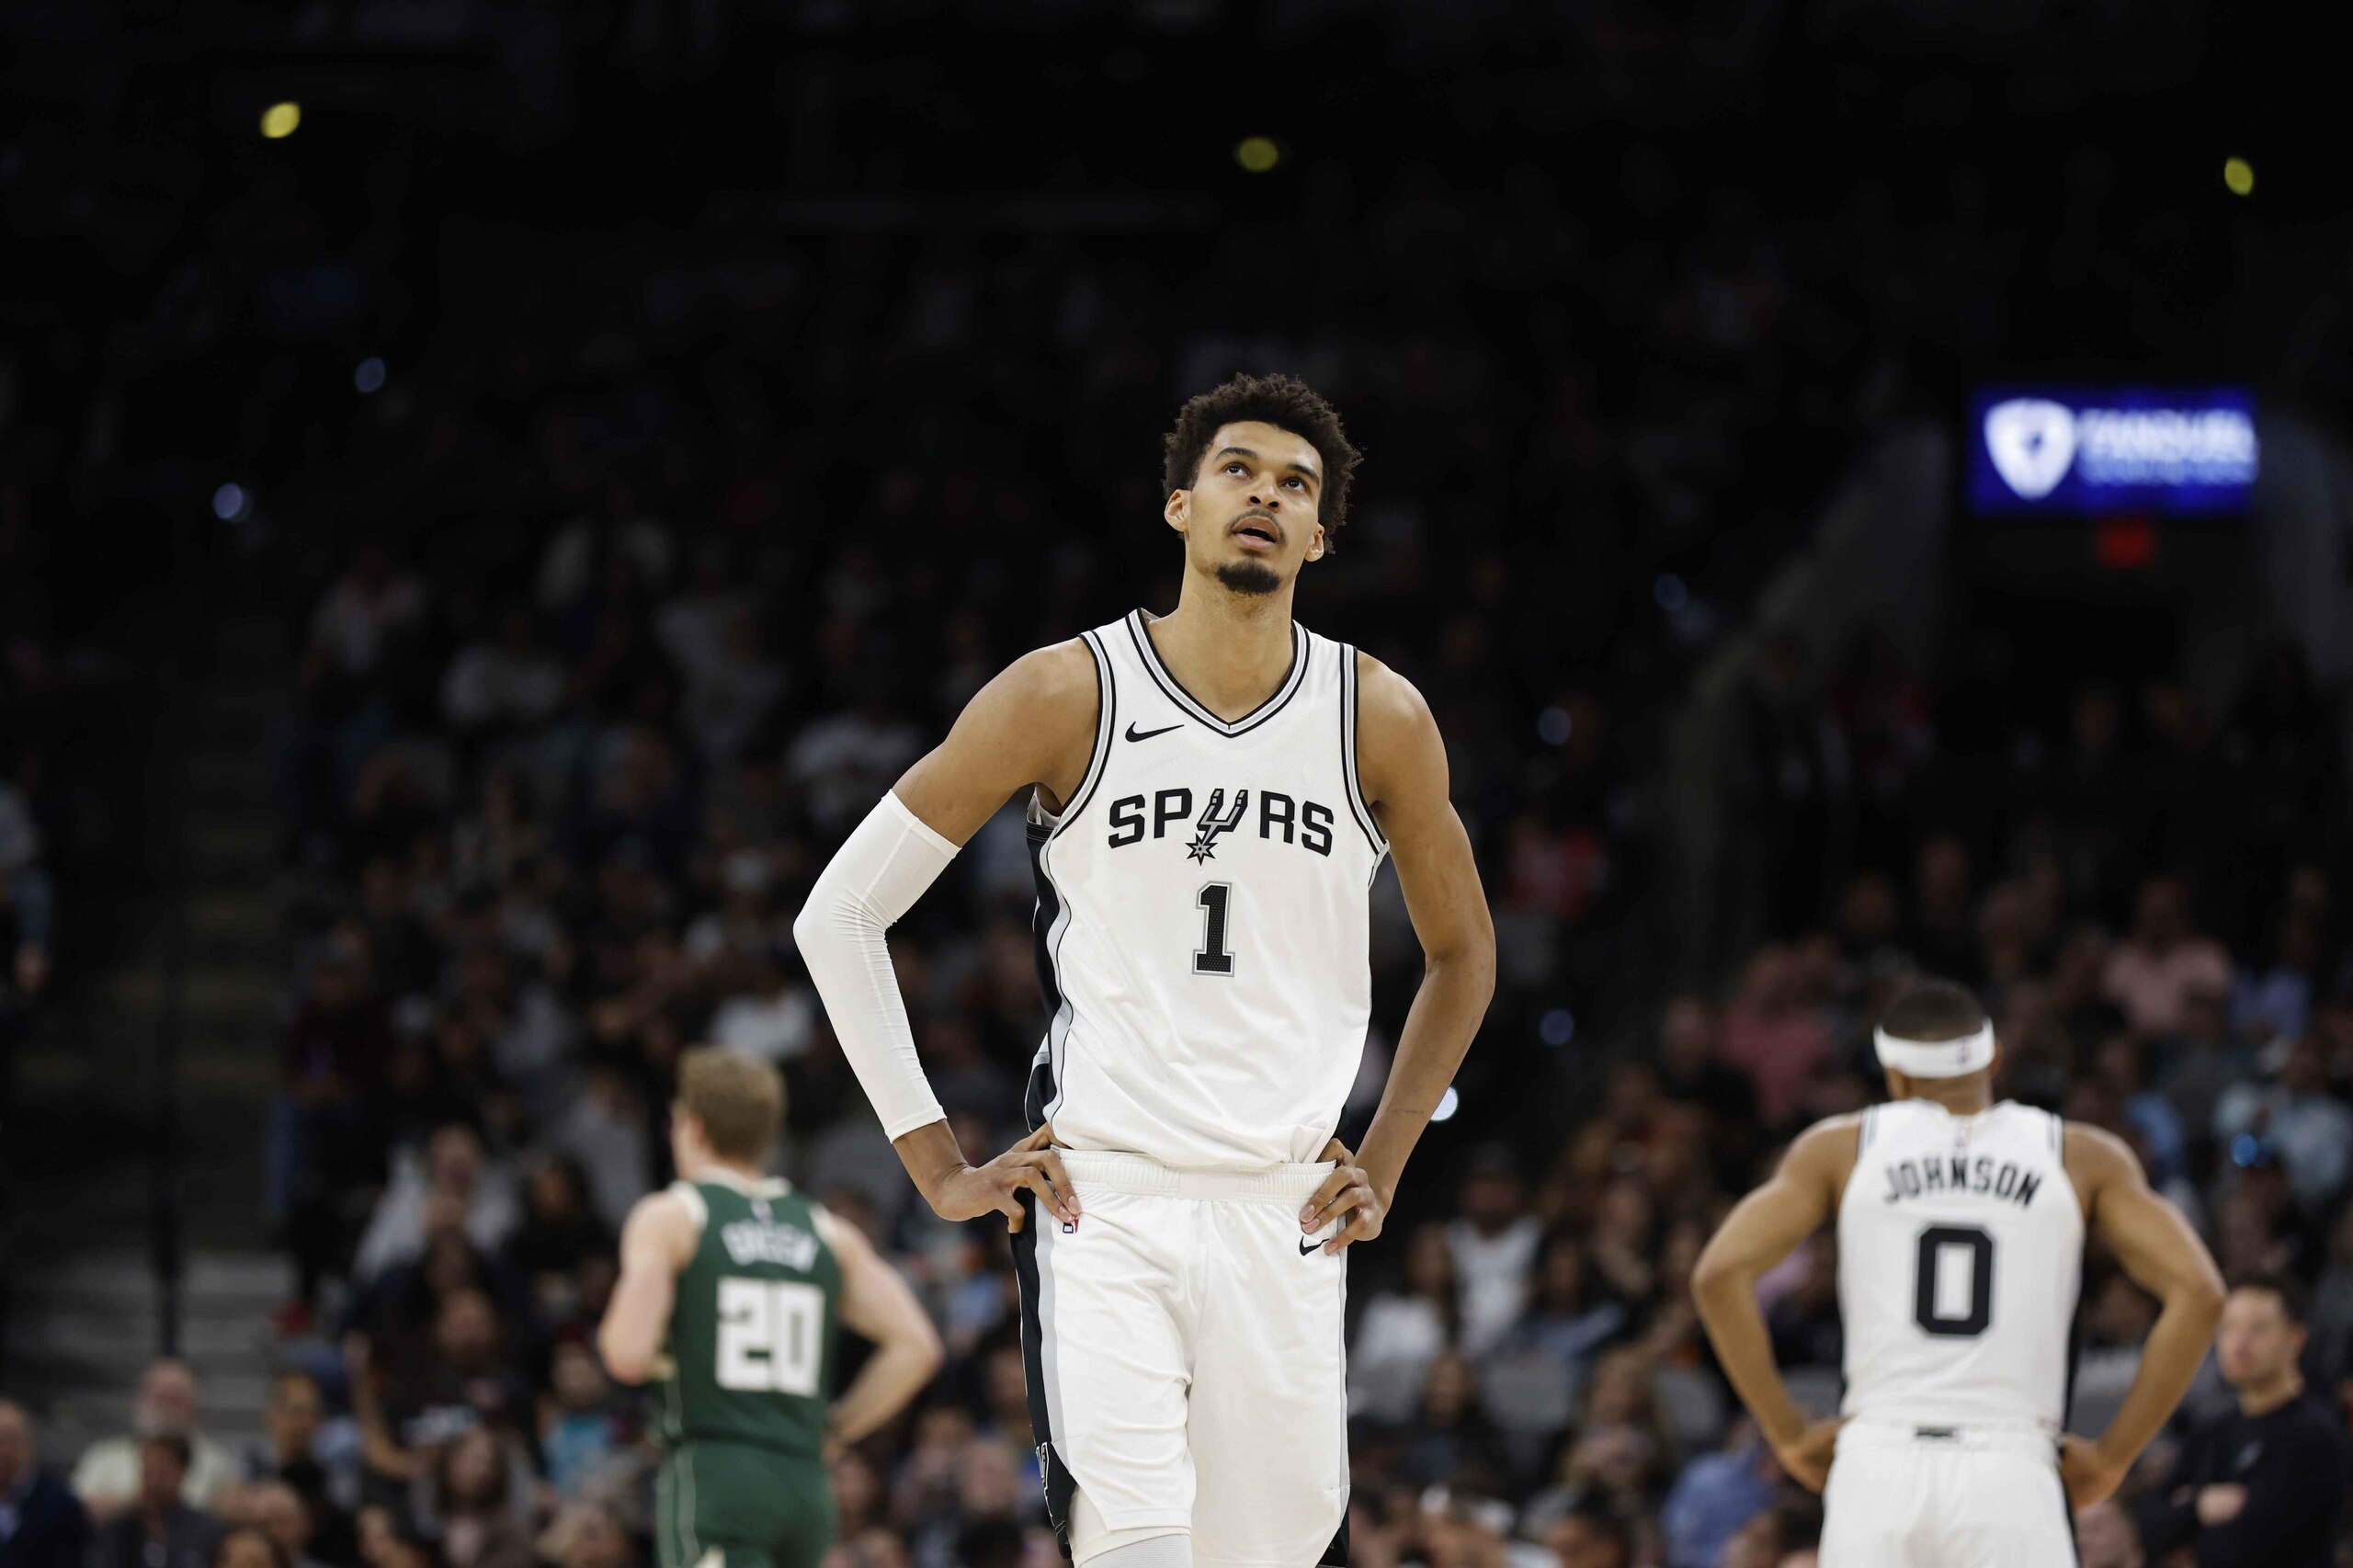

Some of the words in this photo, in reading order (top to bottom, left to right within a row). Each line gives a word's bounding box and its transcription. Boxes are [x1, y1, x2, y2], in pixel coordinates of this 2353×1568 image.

[1108, 788, 1334, 866] SPURS
[1192, 881, 1235, 977] 1
[1883, 1154, 2043, 1207] JOHNSON
[1915, 1224, 1994, 1336] 0
[717, 1276, 825, 1398] 20
